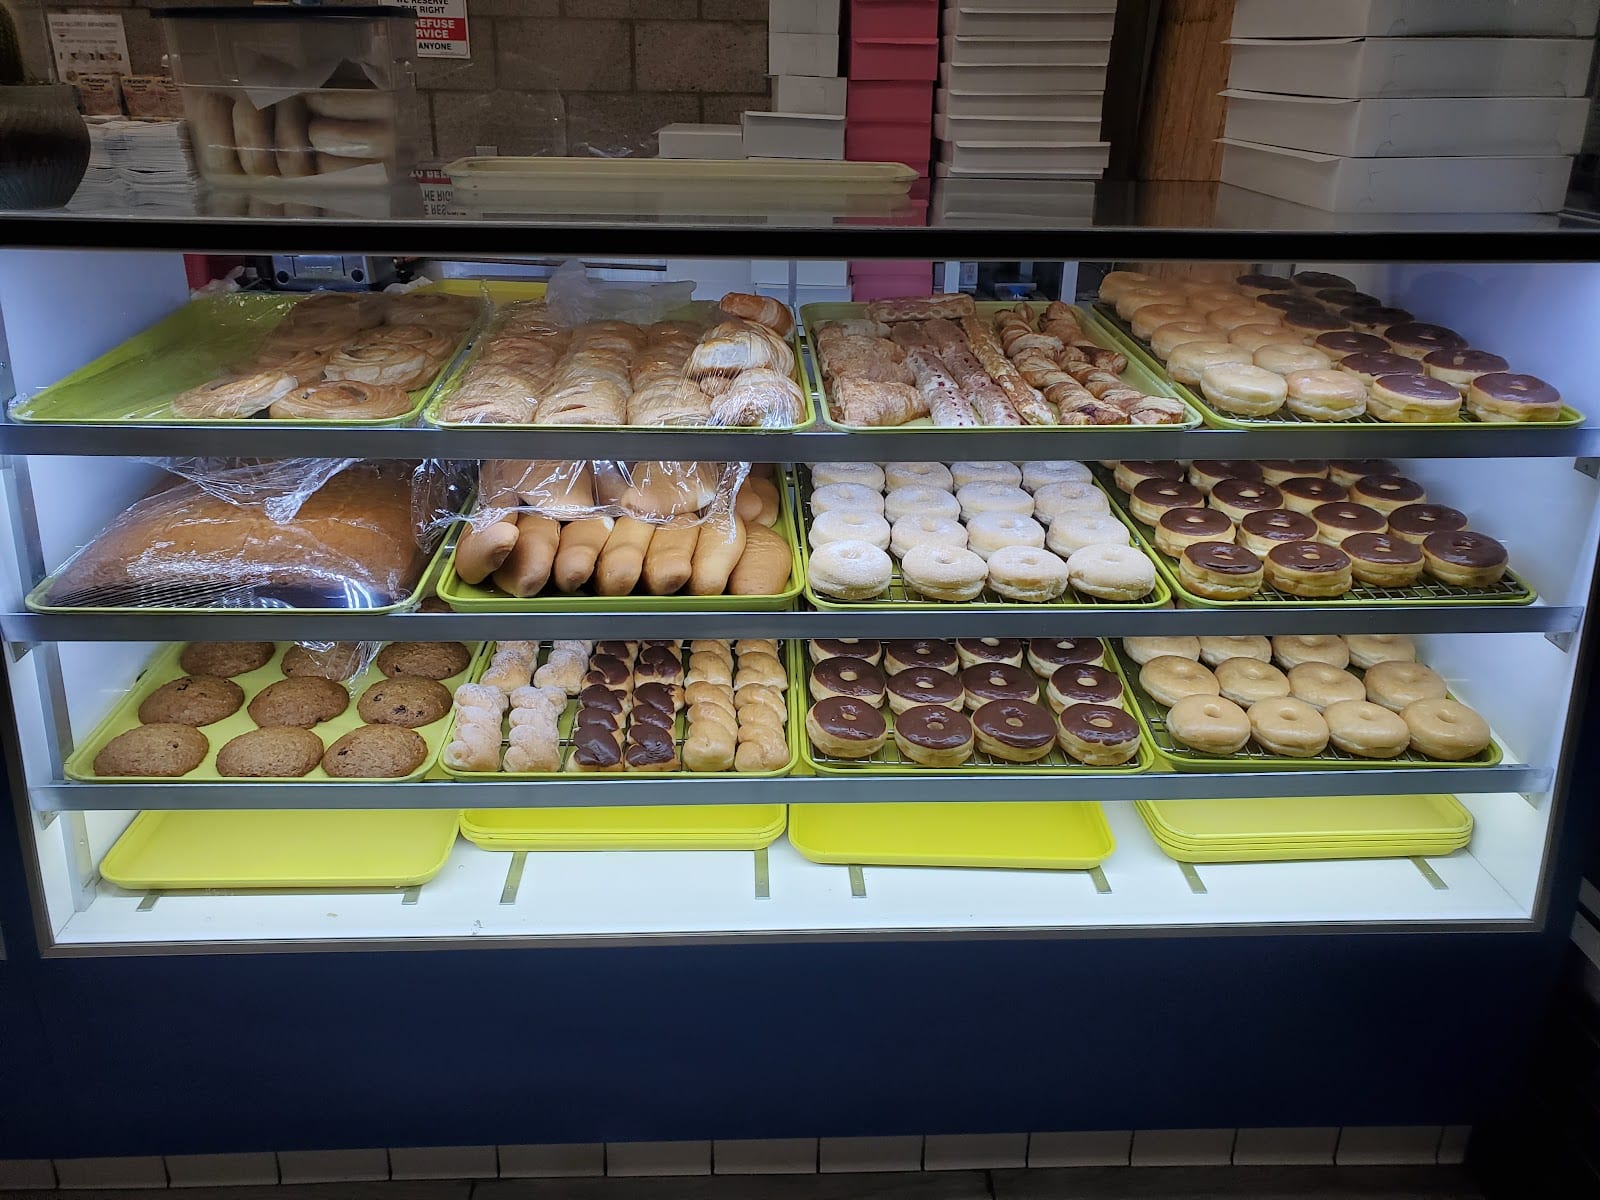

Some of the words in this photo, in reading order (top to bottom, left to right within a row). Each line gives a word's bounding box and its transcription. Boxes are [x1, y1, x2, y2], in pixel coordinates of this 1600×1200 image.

[420, 6, 445, 14] RIGHT
[416, 29, 449, 38] RVICE
[418, 42, 452, 50] ANYONE
